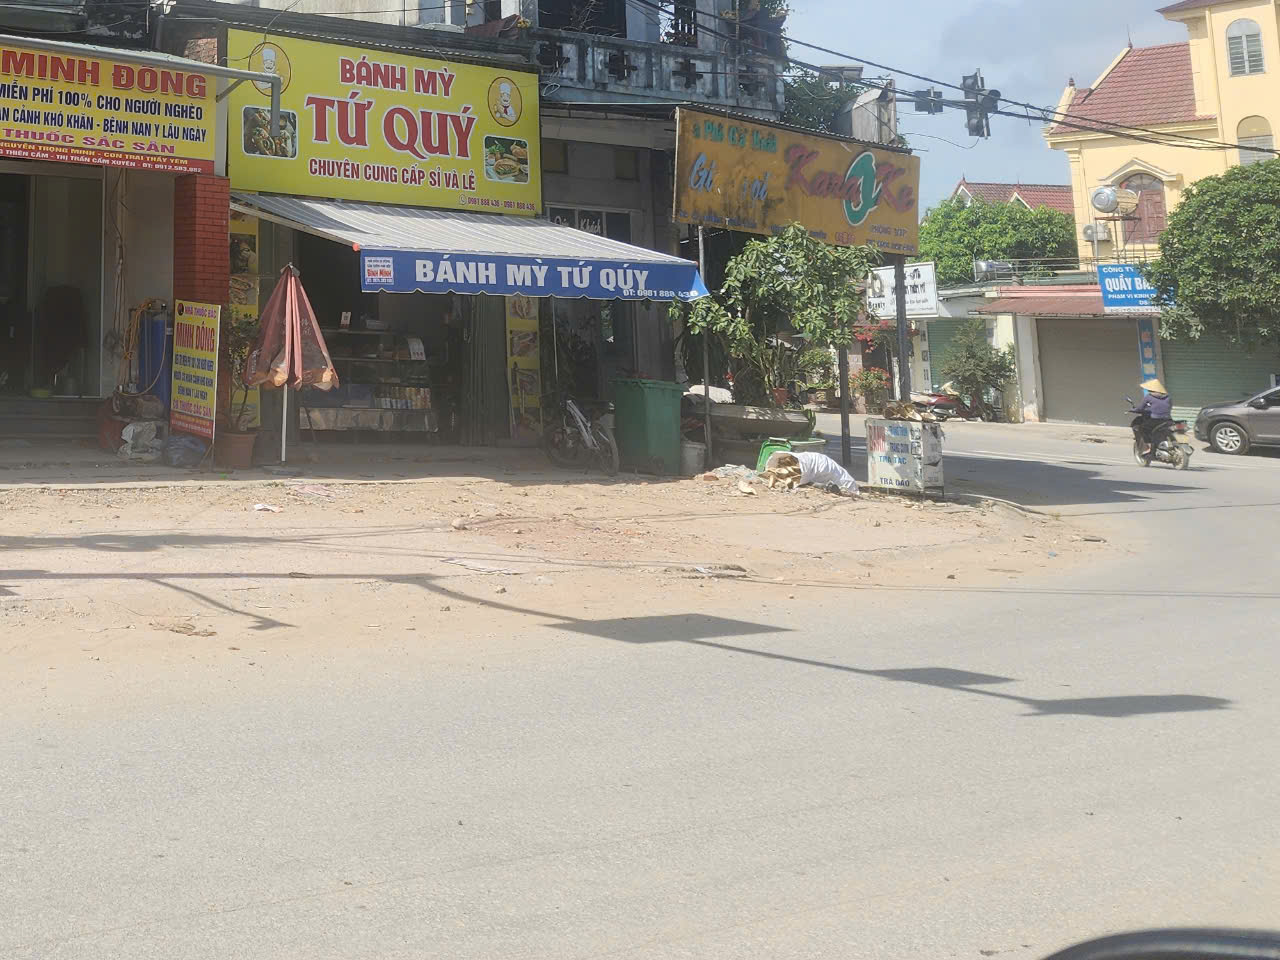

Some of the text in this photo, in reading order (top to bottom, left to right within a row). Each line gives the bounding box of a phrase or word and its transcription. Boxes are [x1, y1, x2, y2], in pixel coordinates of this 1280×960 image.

[1, 49, 100, 86] MINH
[340, 56, 456, 98] BÁNH MỲ
[32, 86, 53, 103] PHÍ
[58, 90, 92, 108] 100%
[96, 95, 121, 111] CHO
[125, 98, 161, 115] NGƯỜI
[164, 103, 203, 120] NGHÈO
[13, 105, 41, 125] CẢNH
[43, 110, 64, 128] KHÓ
[66, 113, 94, 130] KHĂN
[103, 117, 129, 136] BỆNH
[131, 122, 151, 136] NAN
[154, 124, 160, 137] Y
[162, 123, 179, 139] LÂU
[182, 125, 207, 142] NGÀY
[305, 91, 478, 161] TỨ QUÝ
[71, 148, 95, 156] MINH
[309, 158, 476, 191] CHUYÊN CUNG CẤP SỈ VÀ LẺ
[415, 254, 497, 285] BÁNH
[506, 259, 549, 287] MỲ
[557, 260, 593, 288] TỨ
